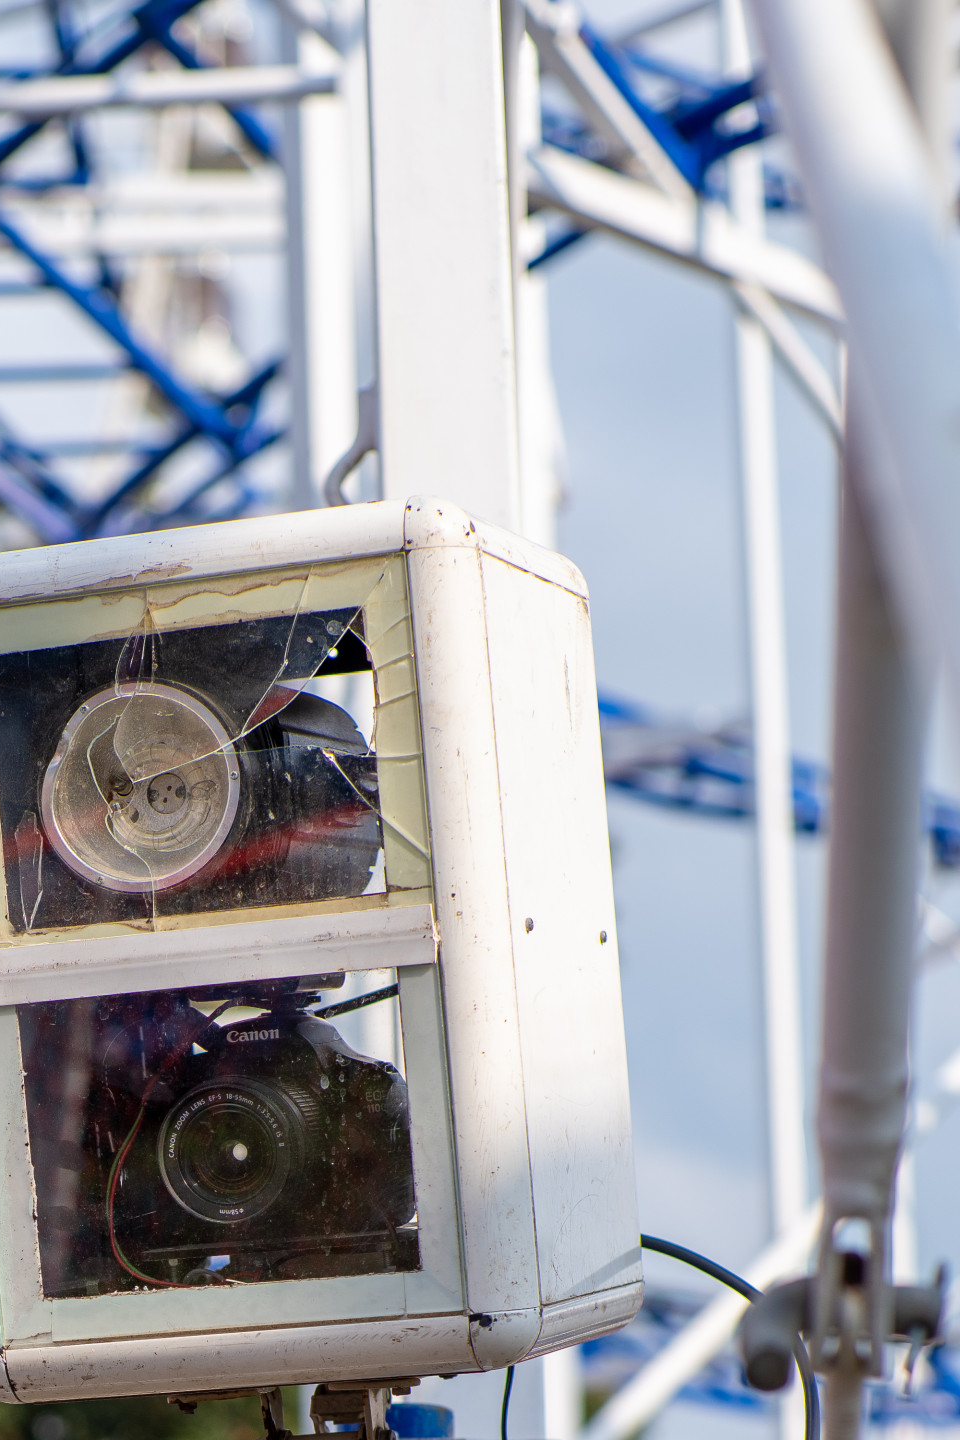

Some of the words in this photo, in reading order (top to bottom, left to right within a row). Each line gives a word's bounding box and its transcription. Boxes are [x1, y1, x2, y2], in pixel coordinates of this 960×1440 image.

[226, 1029, 280, 1043] Canon
[168, 1132, 178, 1158] CANON
[174, 1110, 190, 1131] ZOOM
[190, 1099, 206, 1111] LENS
[208, 1093, 222, 1102] EF-S
[225, 1093, 254, 1106] 18-55mm
